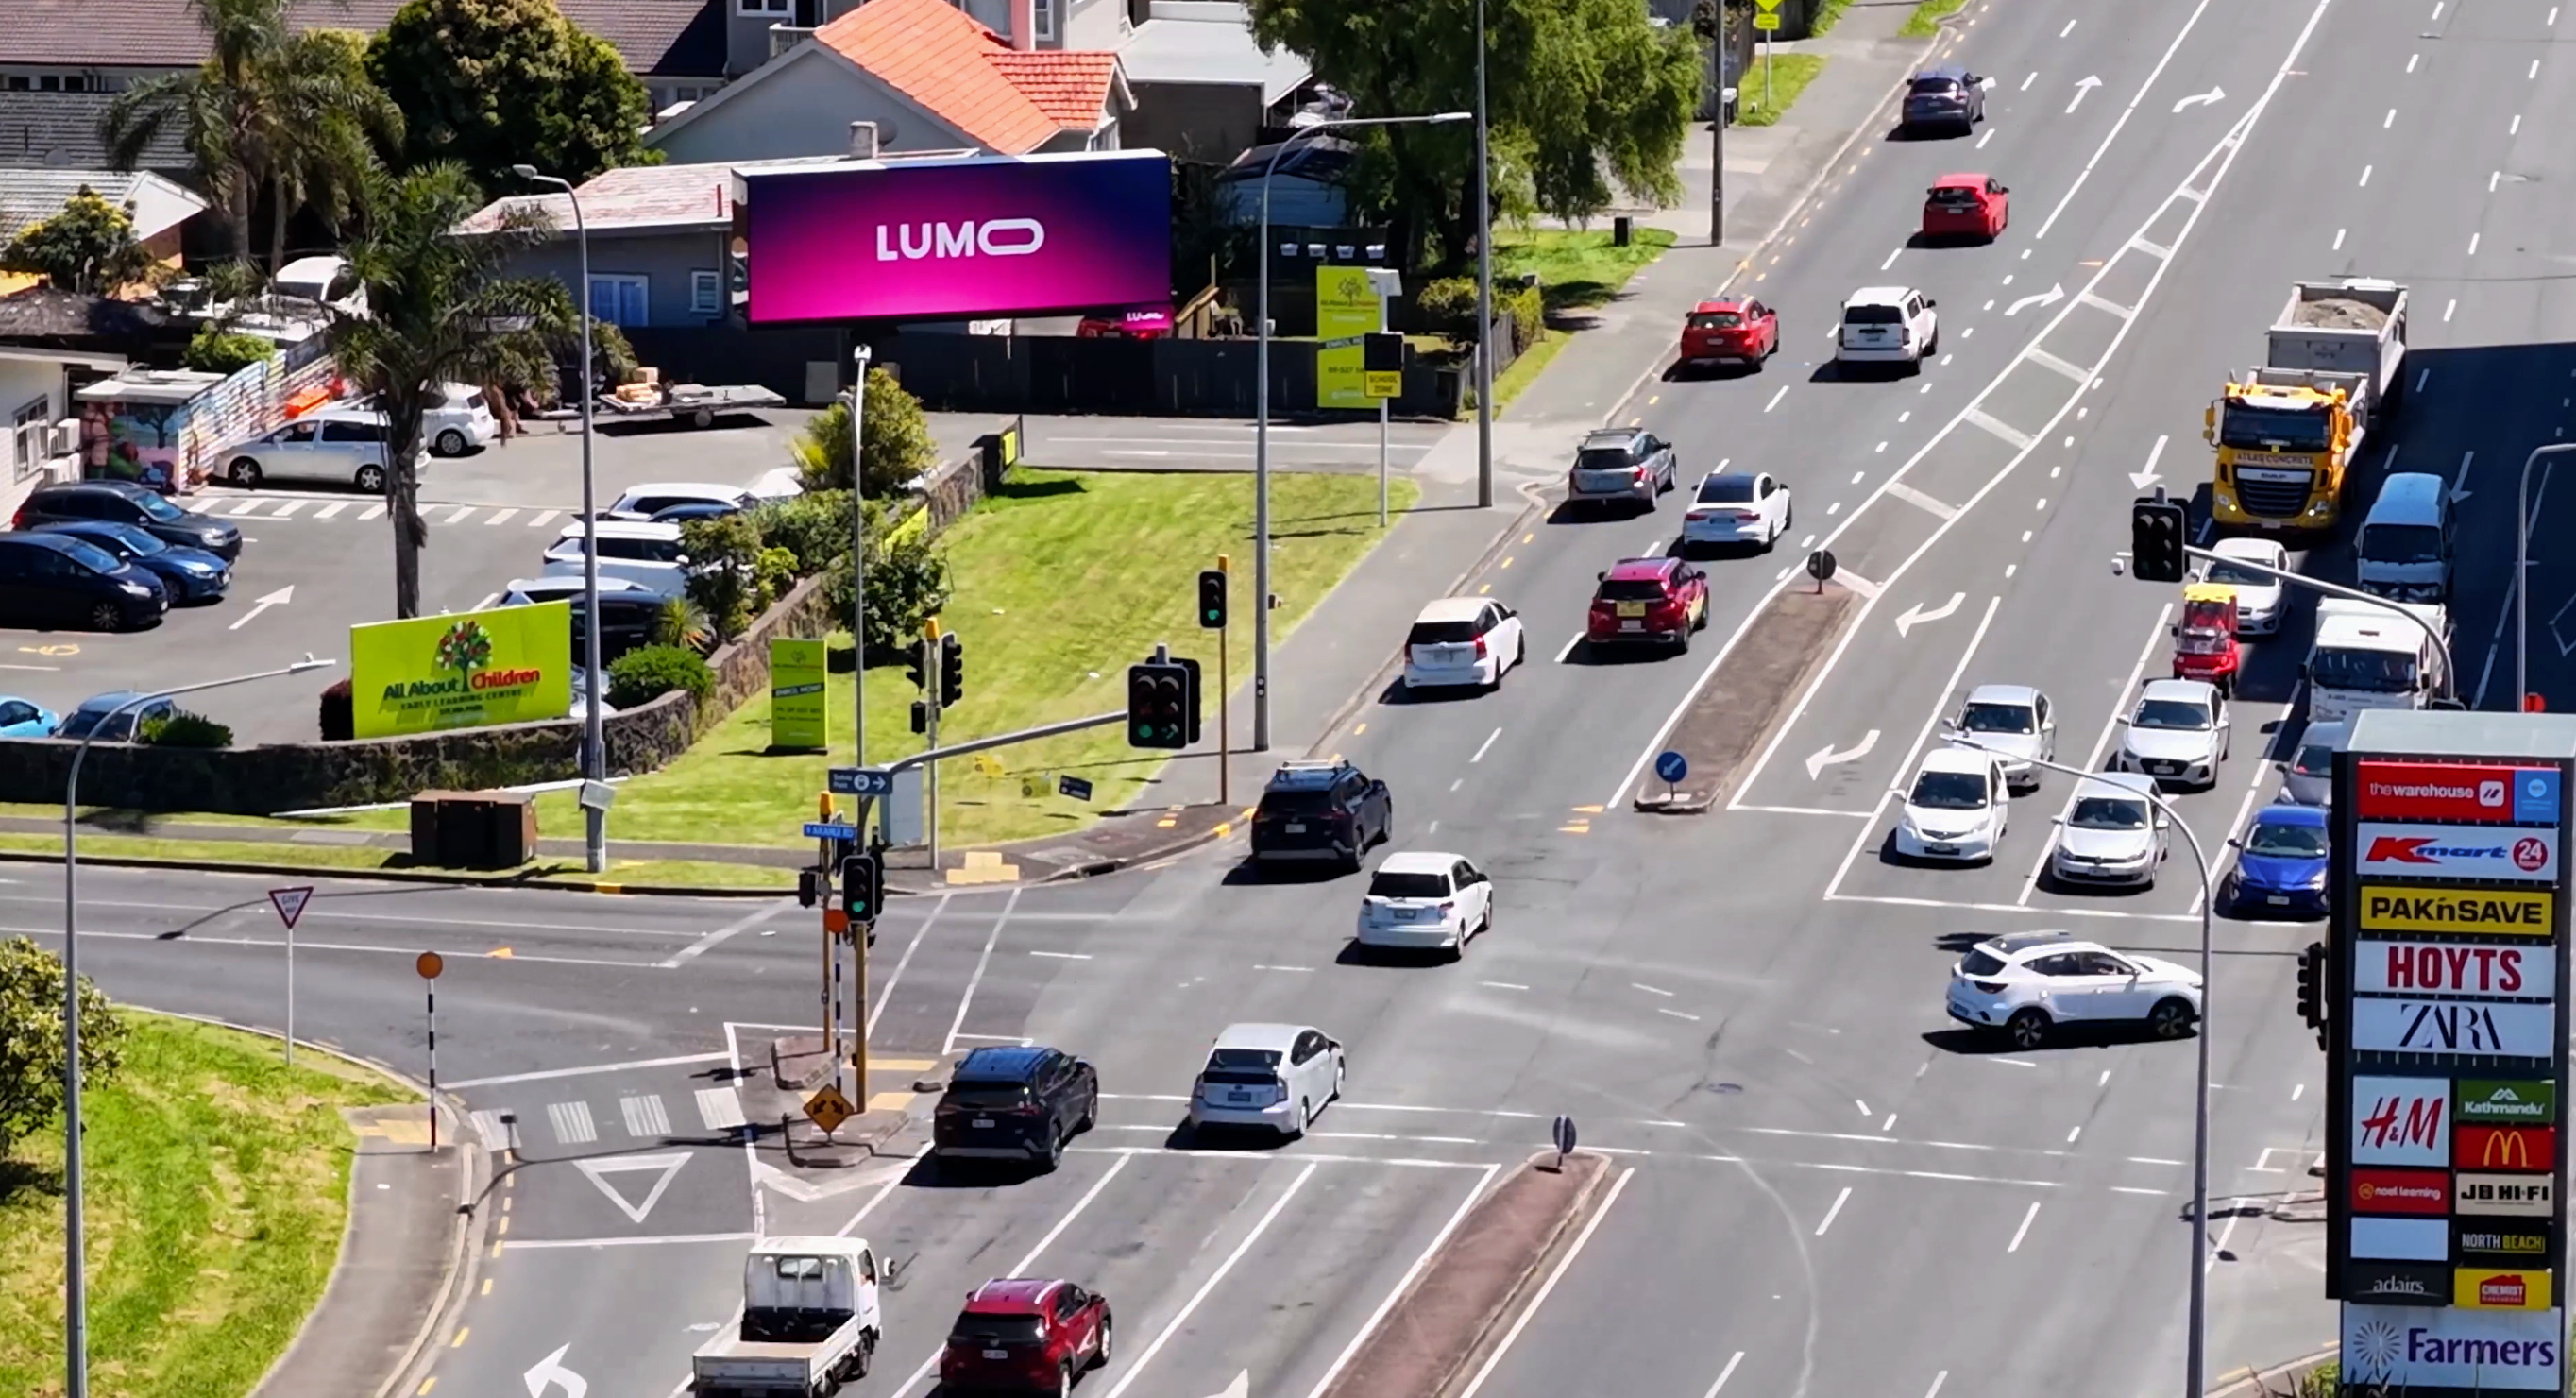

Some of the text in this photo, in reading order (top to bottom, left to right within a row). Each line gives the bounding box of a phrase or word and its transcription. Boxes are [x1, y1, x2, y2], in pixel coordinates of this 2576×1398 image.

[876, 217, 1045, 262] LUMO
[383, 669, 541, 700] All About Children
[2365, 836, 2508, 864] Kmart
[2518, 841, 2542, 860] 24
[2387, 946, 2522, 992] HOYTS
[2399, 1003, 2502, 1050] ZARA
[2464, 1101, 2544, 1116] Kathmandu
[2361, 1096, 2444, 1151] H&M
[2461, 1185, 2494, 1200] JB
[2462, 1234, 2543, 1250] NORTH BEACH
[2372, 1275, 2425, 1293] adairs
[2407, 1327, 2555, 1367] Farmers
